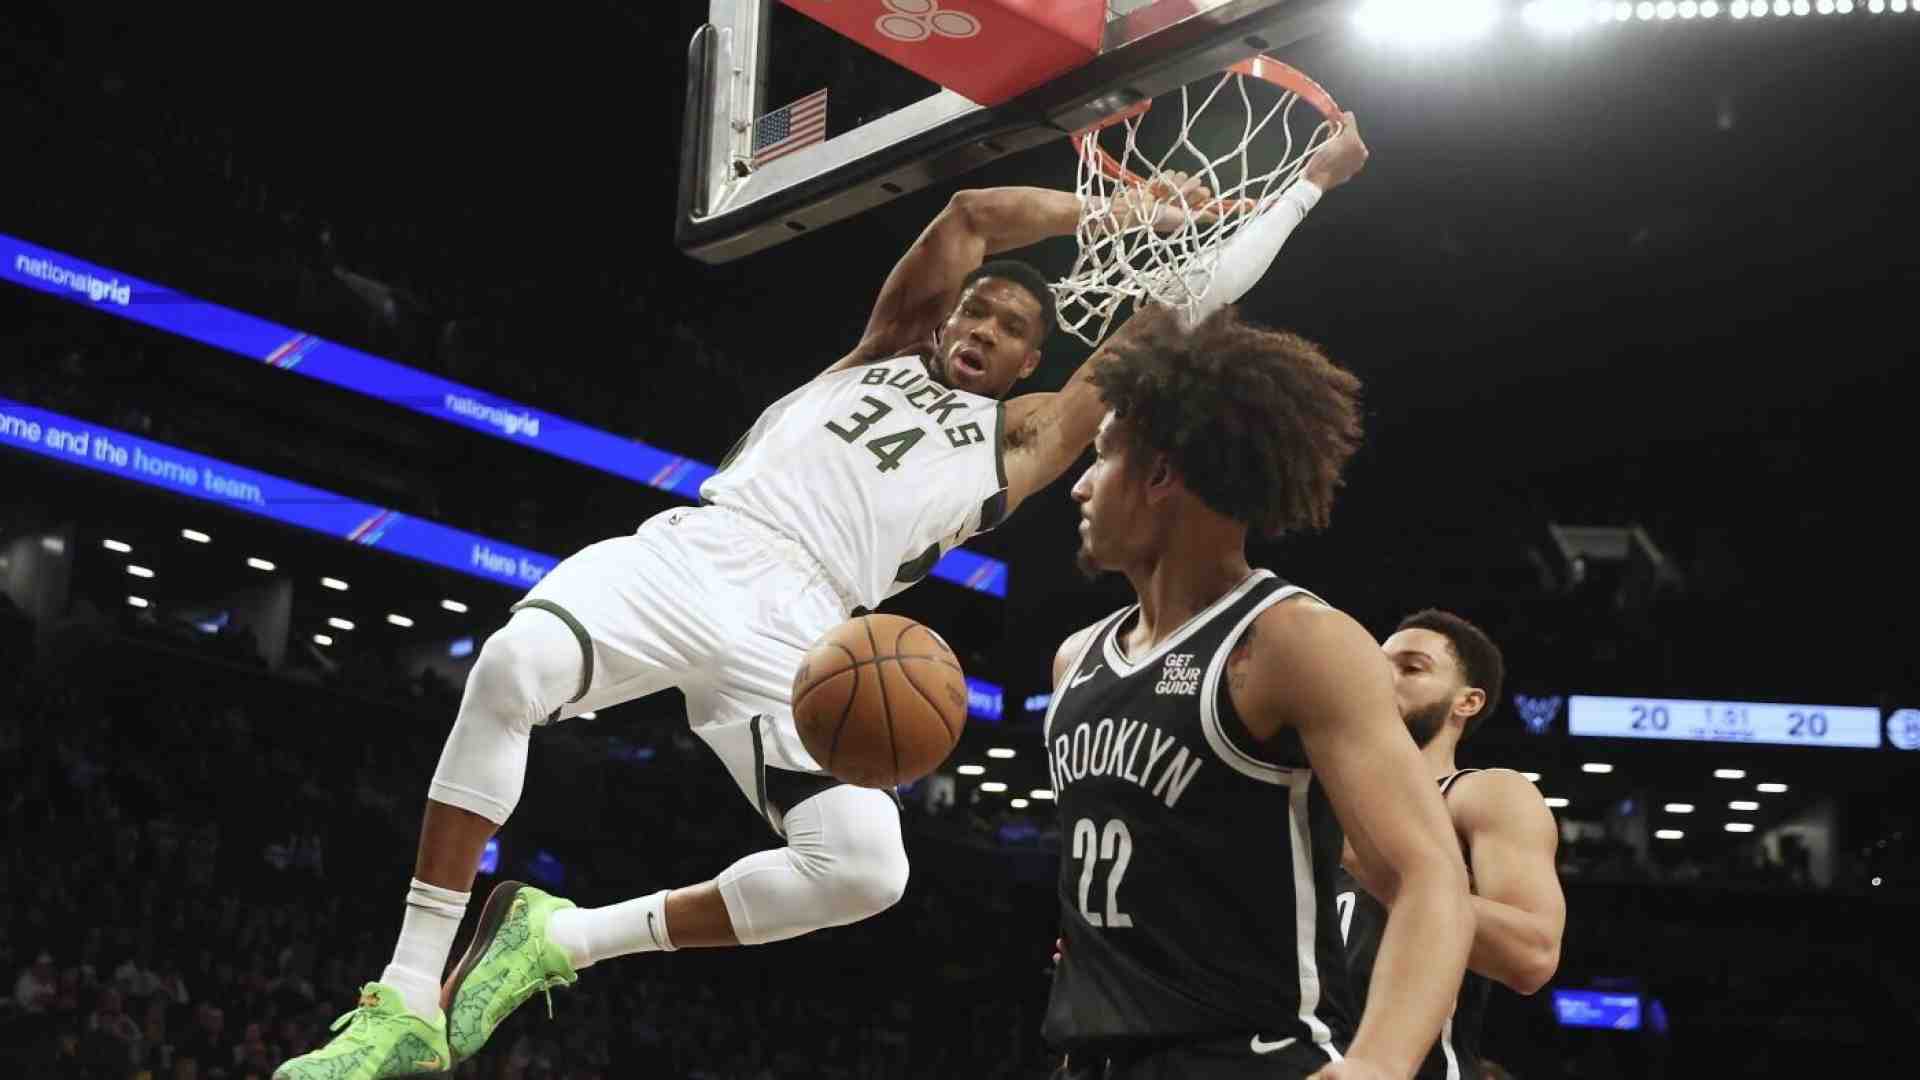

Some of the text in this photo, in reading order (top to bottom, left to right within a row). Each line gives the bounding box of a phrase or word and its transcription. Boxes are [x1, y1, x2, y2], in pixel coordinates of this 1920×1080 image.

[16, 253, 131, 307] nationalgrid
[860, 368, 985, 449] BUCKS
[824, 395, 926, 474] 34
[45, 427, 90, 456] and
[94, 438, 128, 467] the
[133, 447, 198, 486] home
[203, 467, 266, 506] team.
[1162, 667, 1201, 681] YOUR
[1165, 653, 1195, 667] GET
[1155, 681, 1199, 695] GUIDE
[1631, 705, 1671, 731] 20
[1787, 711, 1828, 737] 20
[1073, 818, 1134, 928] 22
